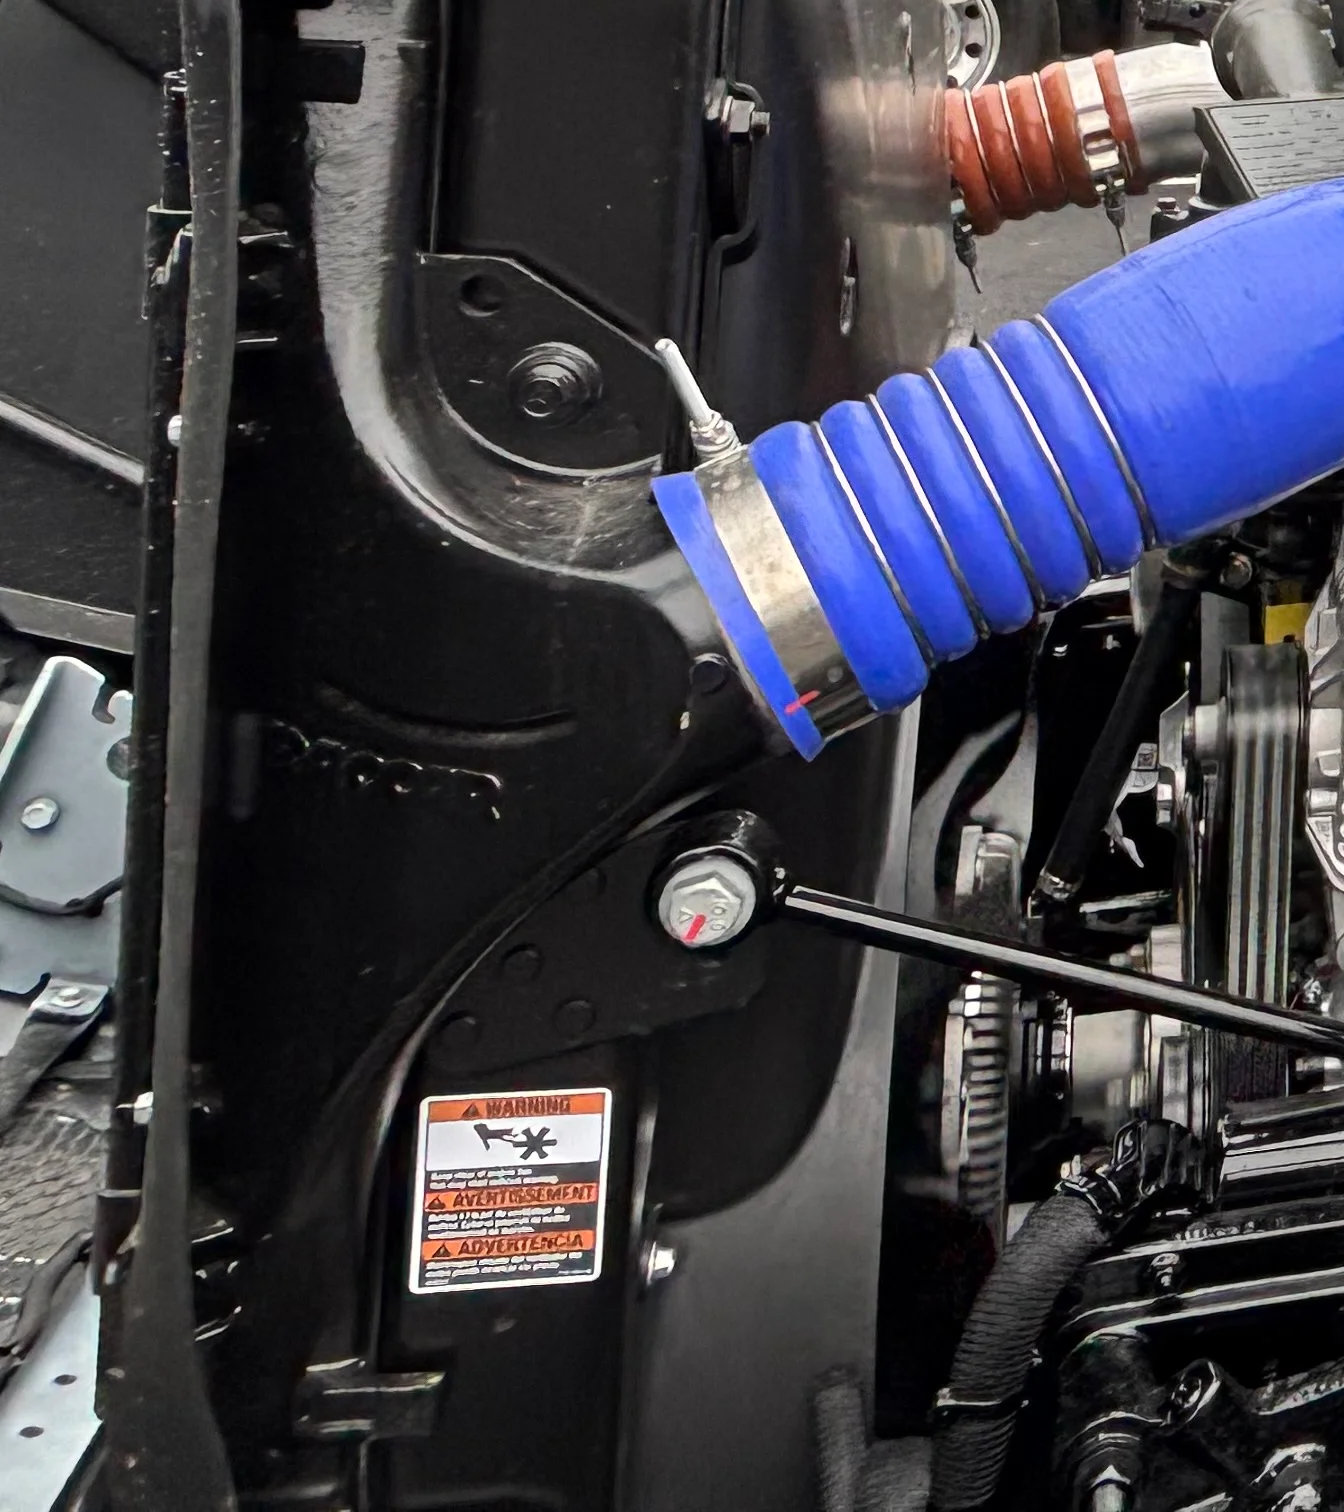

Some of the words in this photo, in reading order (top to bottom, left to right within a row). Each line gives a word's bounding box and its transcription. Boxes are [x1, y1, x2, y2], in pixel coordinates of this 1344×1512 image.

[485, 1096, 571, 1118] WARNING
[453, 1184, 594, 1208] AVERTISSEMENT
[458, 1233, 584, 1256] ADVERTENCIA
